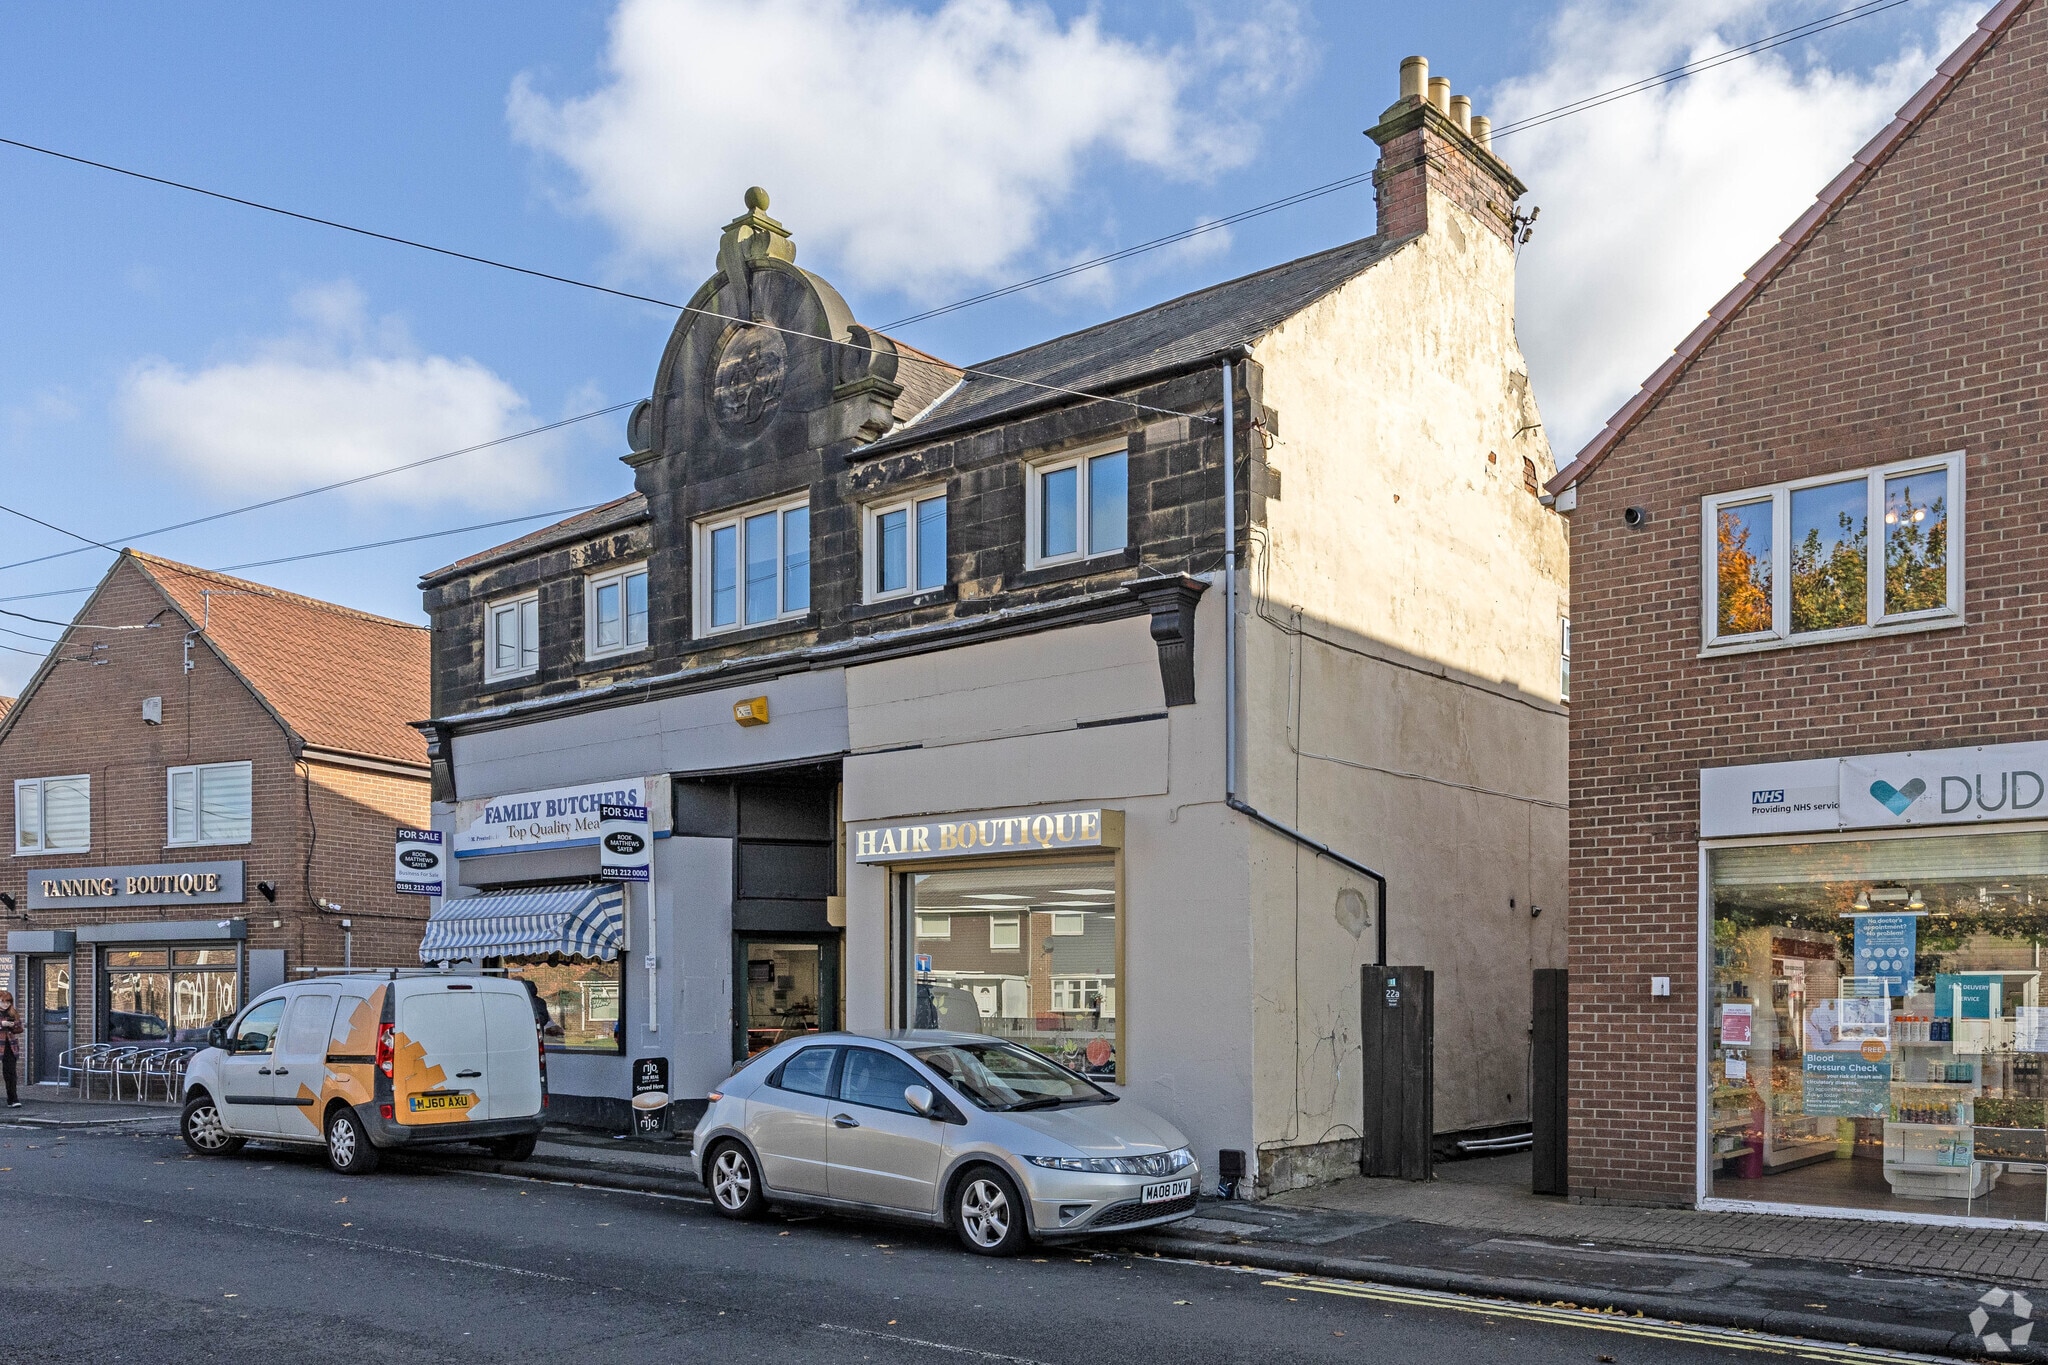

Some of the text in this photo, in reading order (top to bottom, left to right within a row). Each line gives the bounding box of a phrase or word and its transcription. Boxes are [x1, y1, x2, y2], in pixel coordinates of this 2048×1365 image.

[1754, 791, 1783, 803] NHS
[1941, 771, 2045, 814] DUD
[485, 801, 541, 824] FAMILY
[546, 788, 637, 818] BUTCHERS
[1752, 805, 1791, 814] Providing
[1793, 803, 1812, 812] NHS
[603, 806, 645, 818] FOR SALE
[399, 830, 440, 841] FOR SALE
[507, 825, 527, 840] Top
[530, 820, 571, 839] Quality
[856, 811, 1101, 857] HAIR BOUTIQUE
[404, 856, 434, 864] MATTHEWS
[602, 868, 619, 876] 0191
[41, 873, 218, 897] TANNING BOUTIQUE
[1386, 990, 1400, 998] 22a
[1807, 1054, 1834, 1062] Blood
[1807, 1063, 1878, 1072] Pressure Check
[636, 1084, 653, 1092] Served
[448, 1096, 468, 1107] AXU
[1146, 1185, 1170, 1199] MA08
